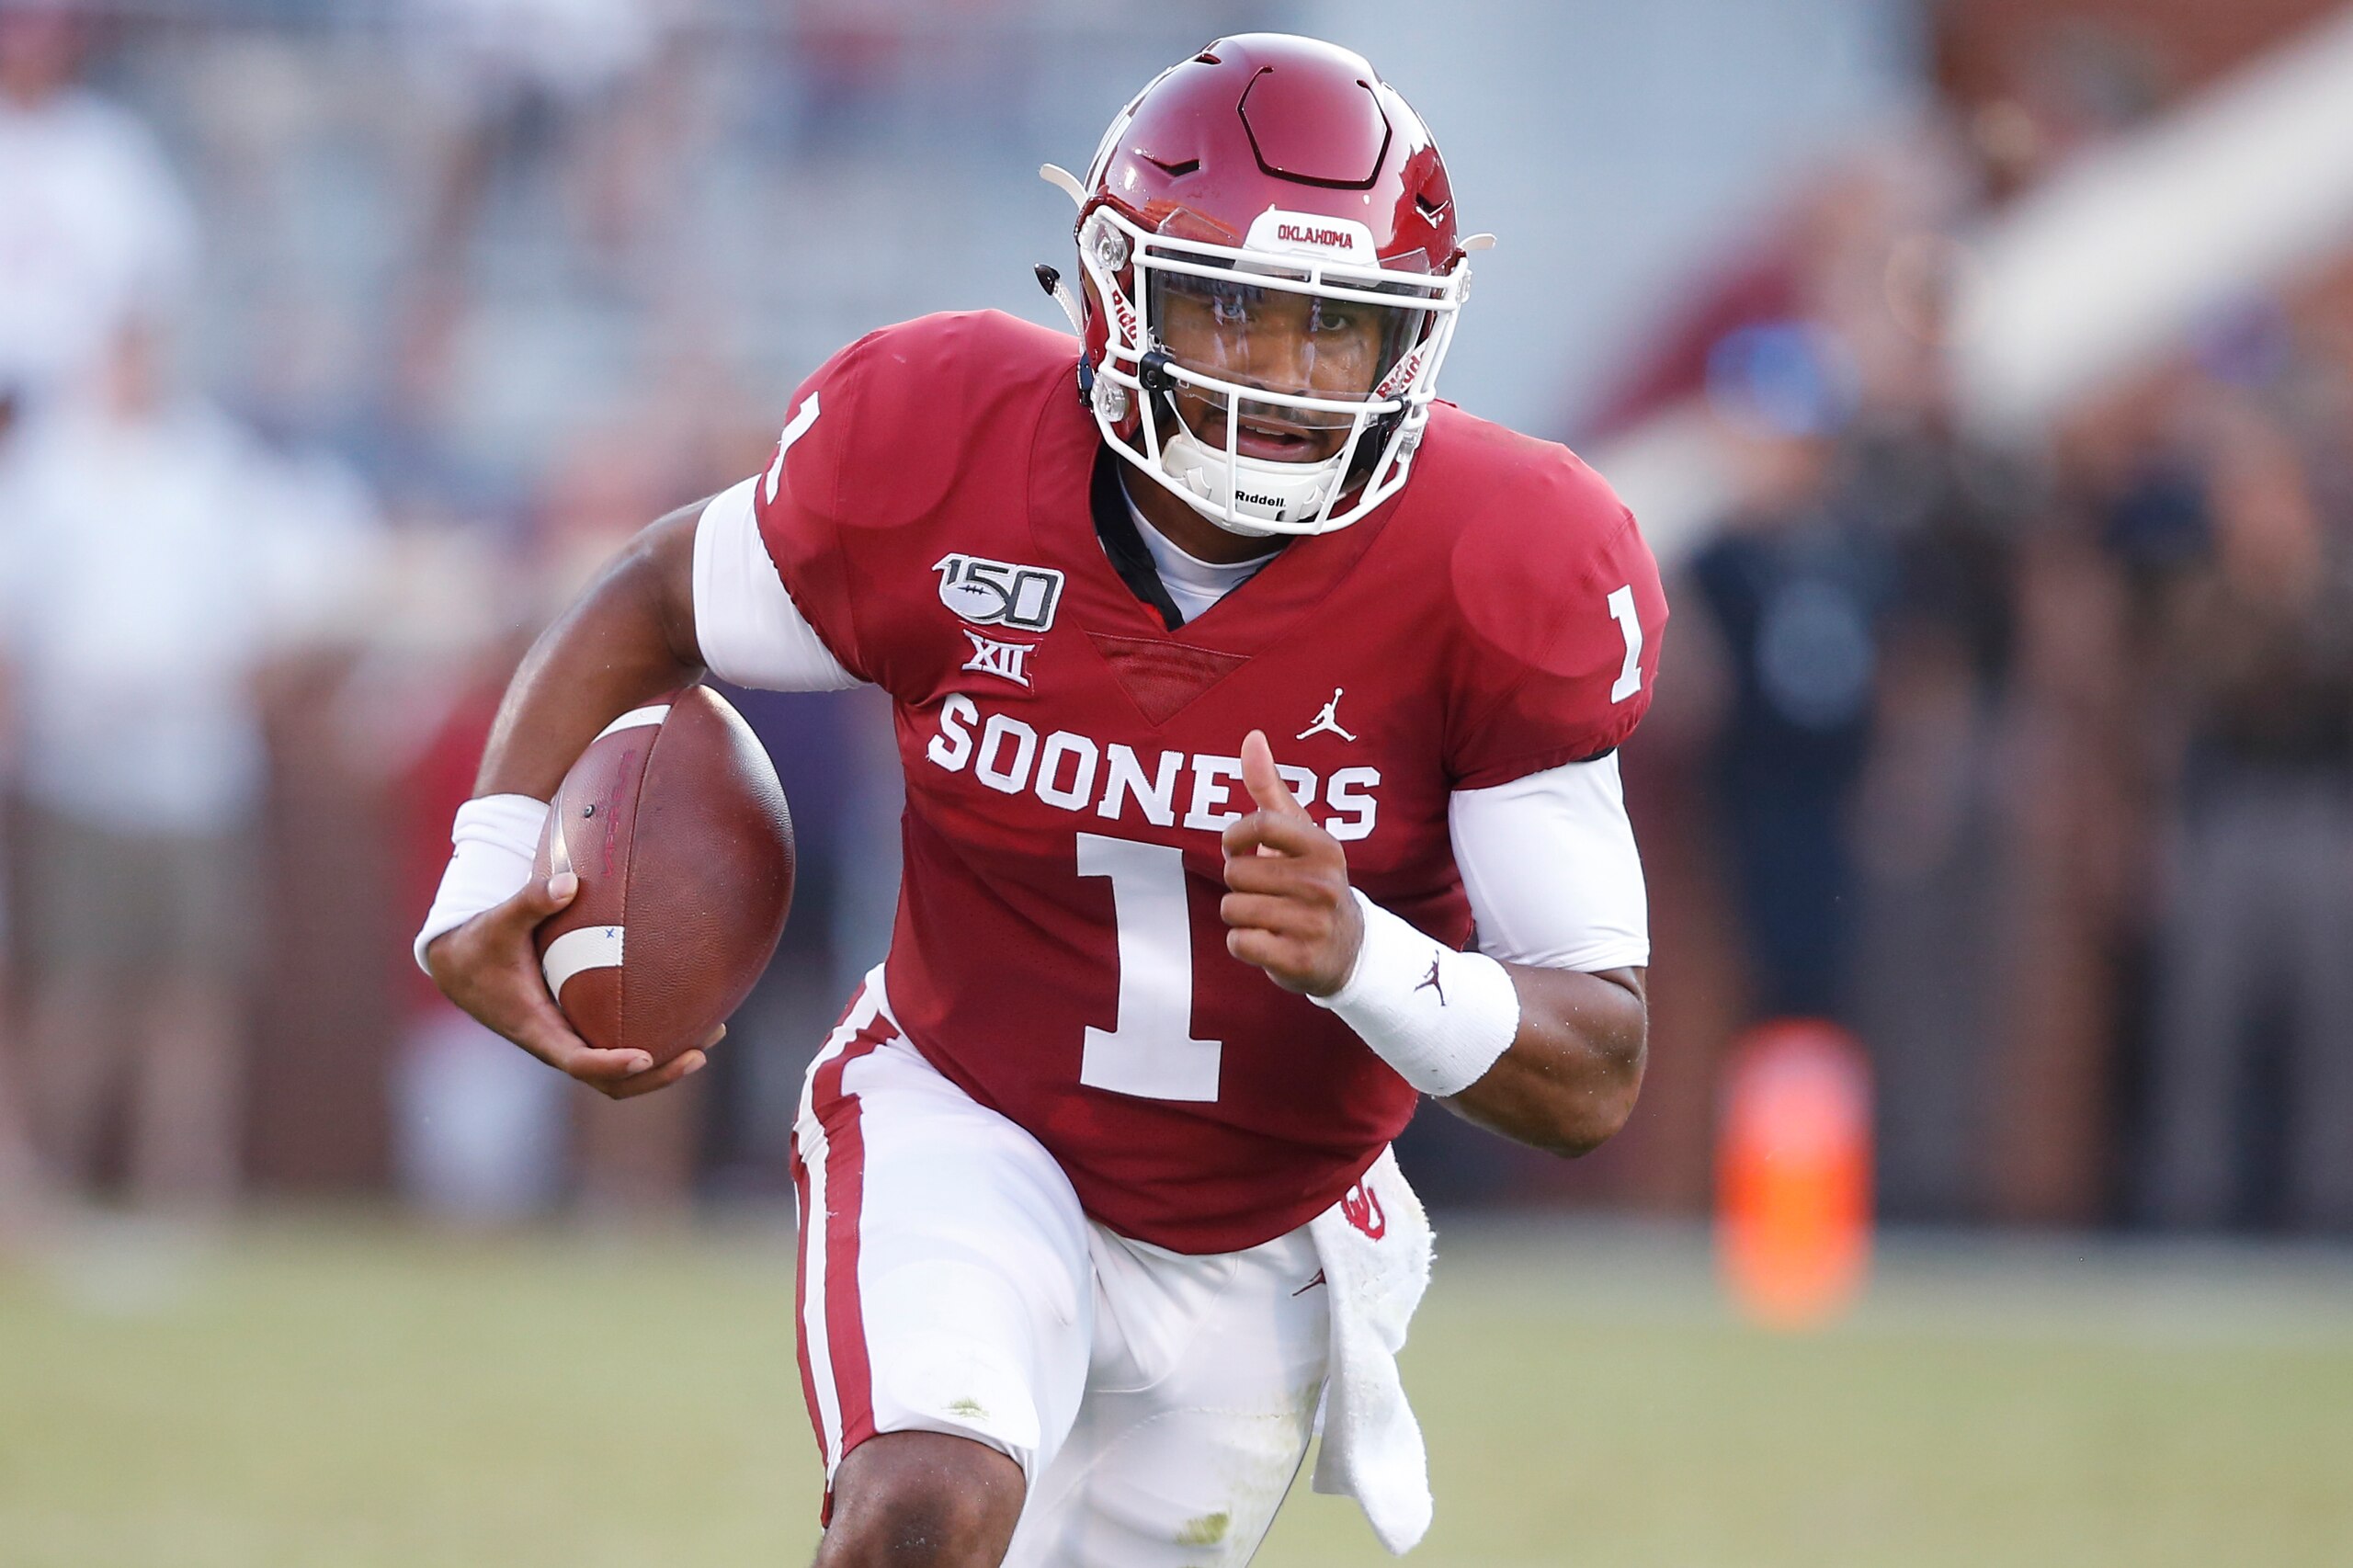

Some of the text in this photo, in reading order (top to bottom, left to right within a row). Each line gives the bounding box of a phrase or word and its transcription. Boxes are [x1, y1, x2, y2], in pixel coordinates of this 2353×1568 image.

[1278, 224, 1353, 249] OKLAHOMA
[936, 554, 1063, 631] 150
[961, 629, 1035, 687] XII
[1607, 584, 1643, 704] 1
[1076, 832, 1222, 1102] 1
